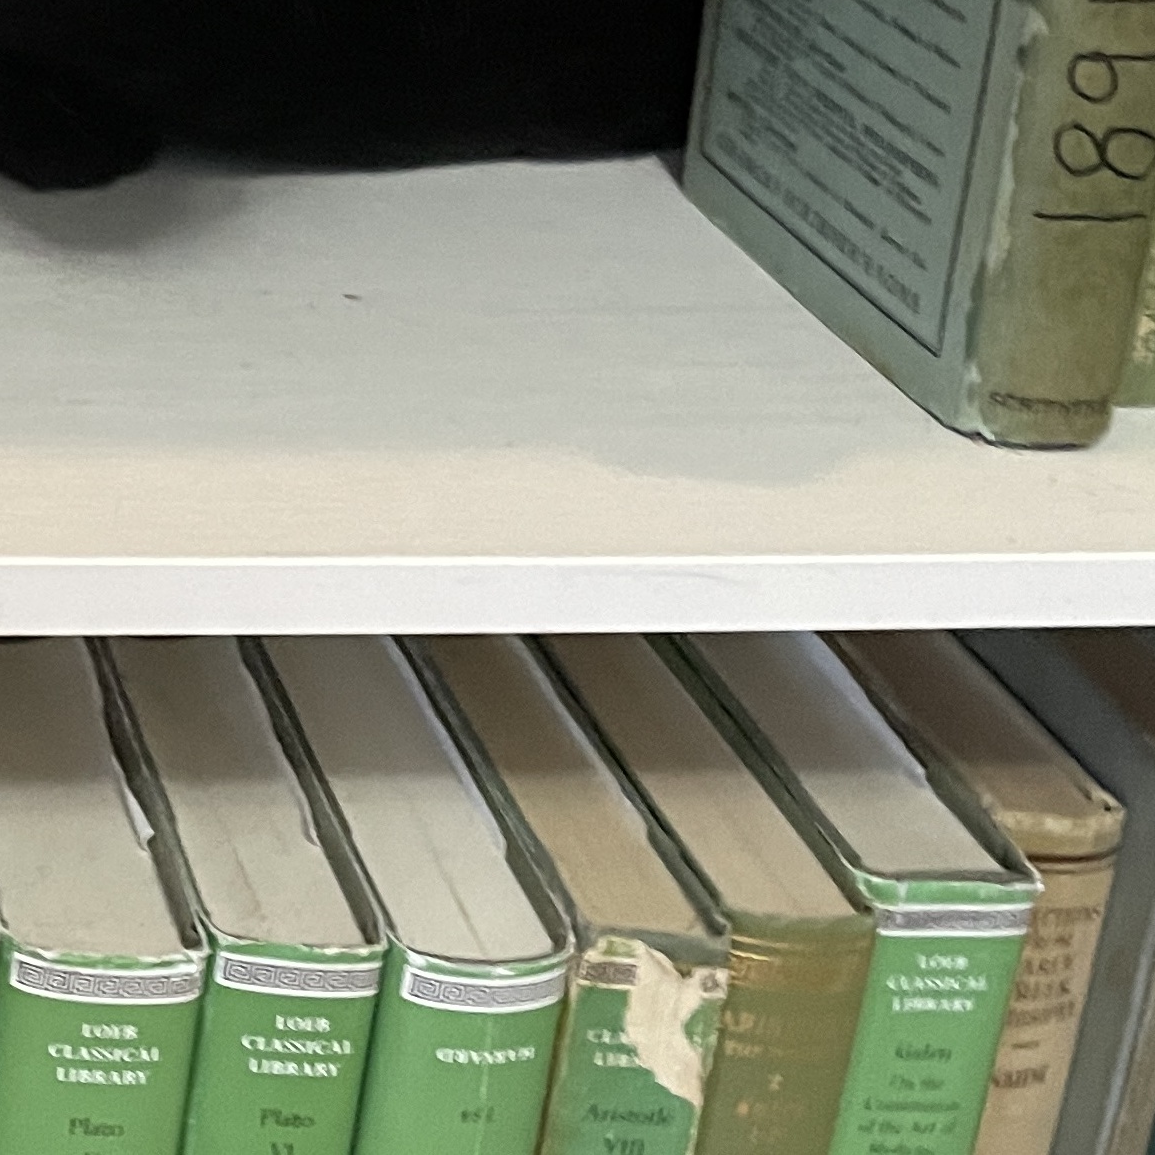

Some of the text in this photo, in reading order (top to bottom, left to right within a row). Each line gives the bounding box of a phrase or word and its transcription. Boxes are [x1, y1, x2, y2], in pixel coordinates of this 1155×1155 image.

[47, 1043, 160, 1062] CLASSICAL
[240, 1034, 353, 1055] CLASSICAL
[55, 1066, 149, 1085] LIBRARY
[248, 1056, 340, 1078] LIBRARY
